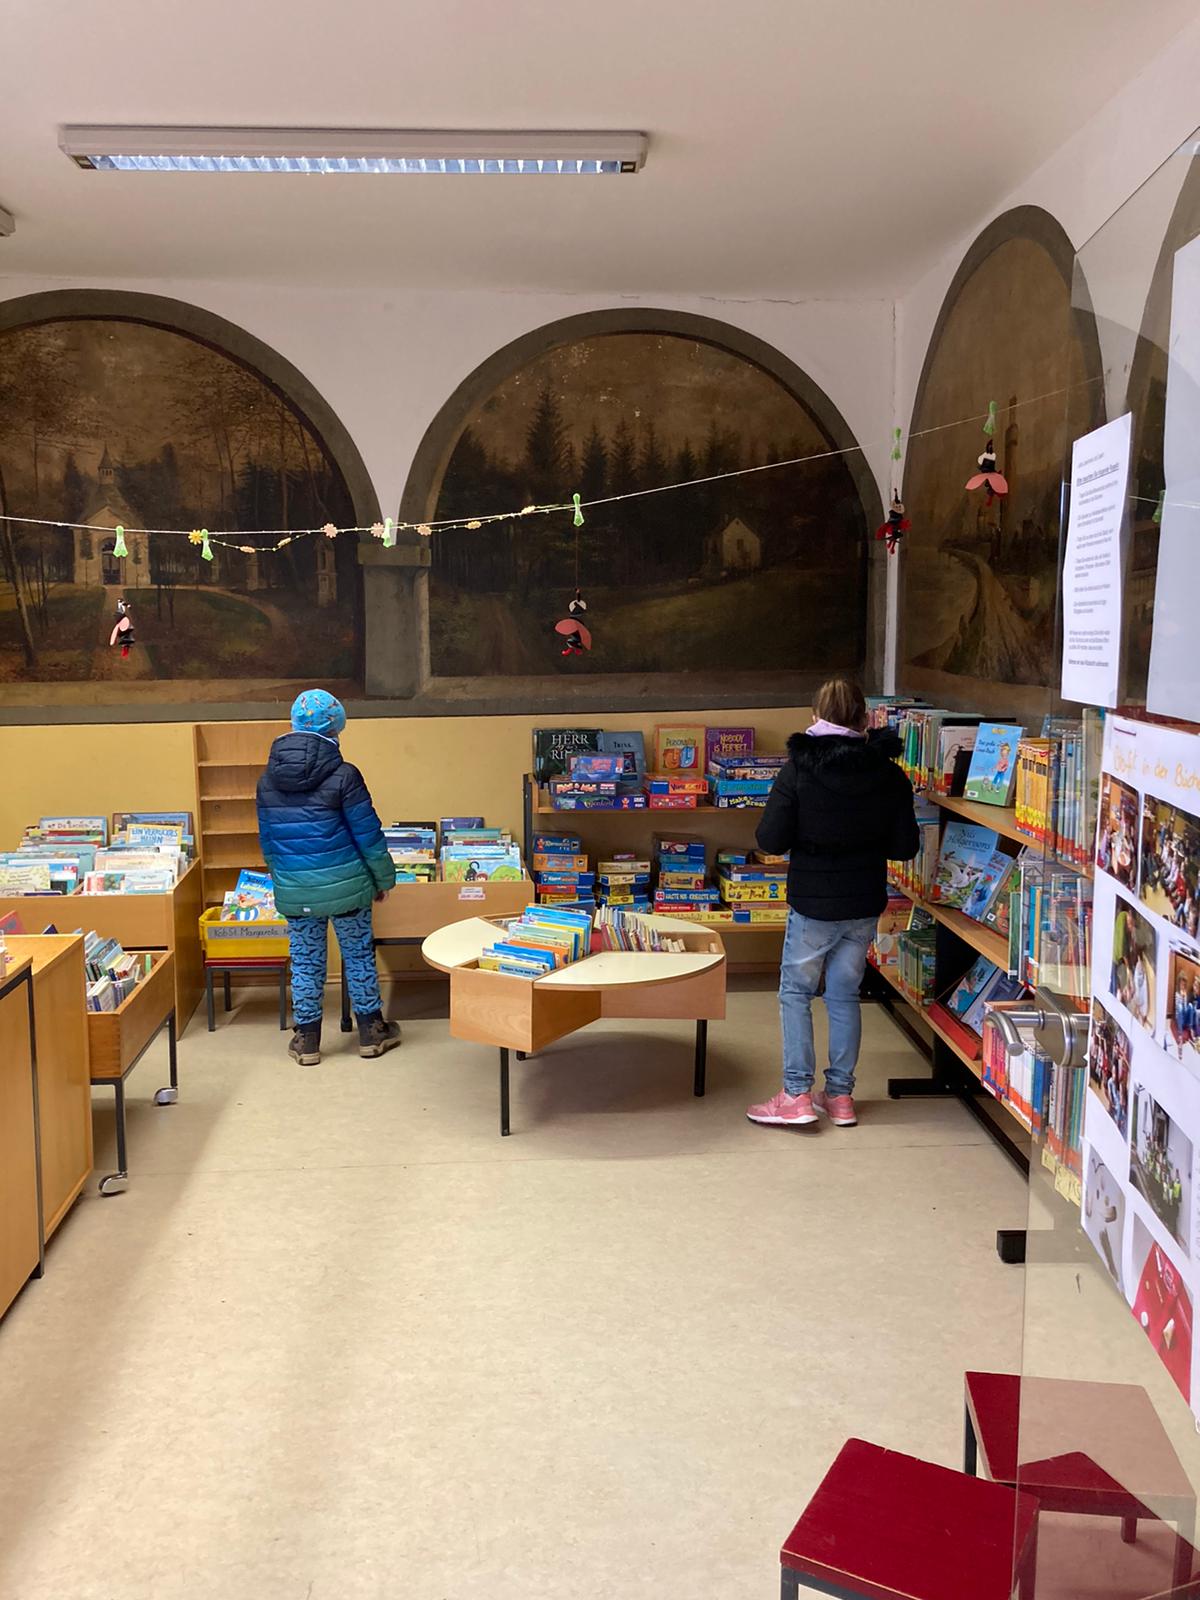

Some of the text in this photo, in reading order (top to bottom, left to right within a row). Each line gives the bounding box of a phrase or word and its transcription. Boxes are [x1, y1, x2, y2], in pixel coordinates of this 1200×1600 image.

[551, 734, 590, 746] HERR
[720, 734, 745, 744] NOBODY
[721, 743, 747, 752] PERFECT
